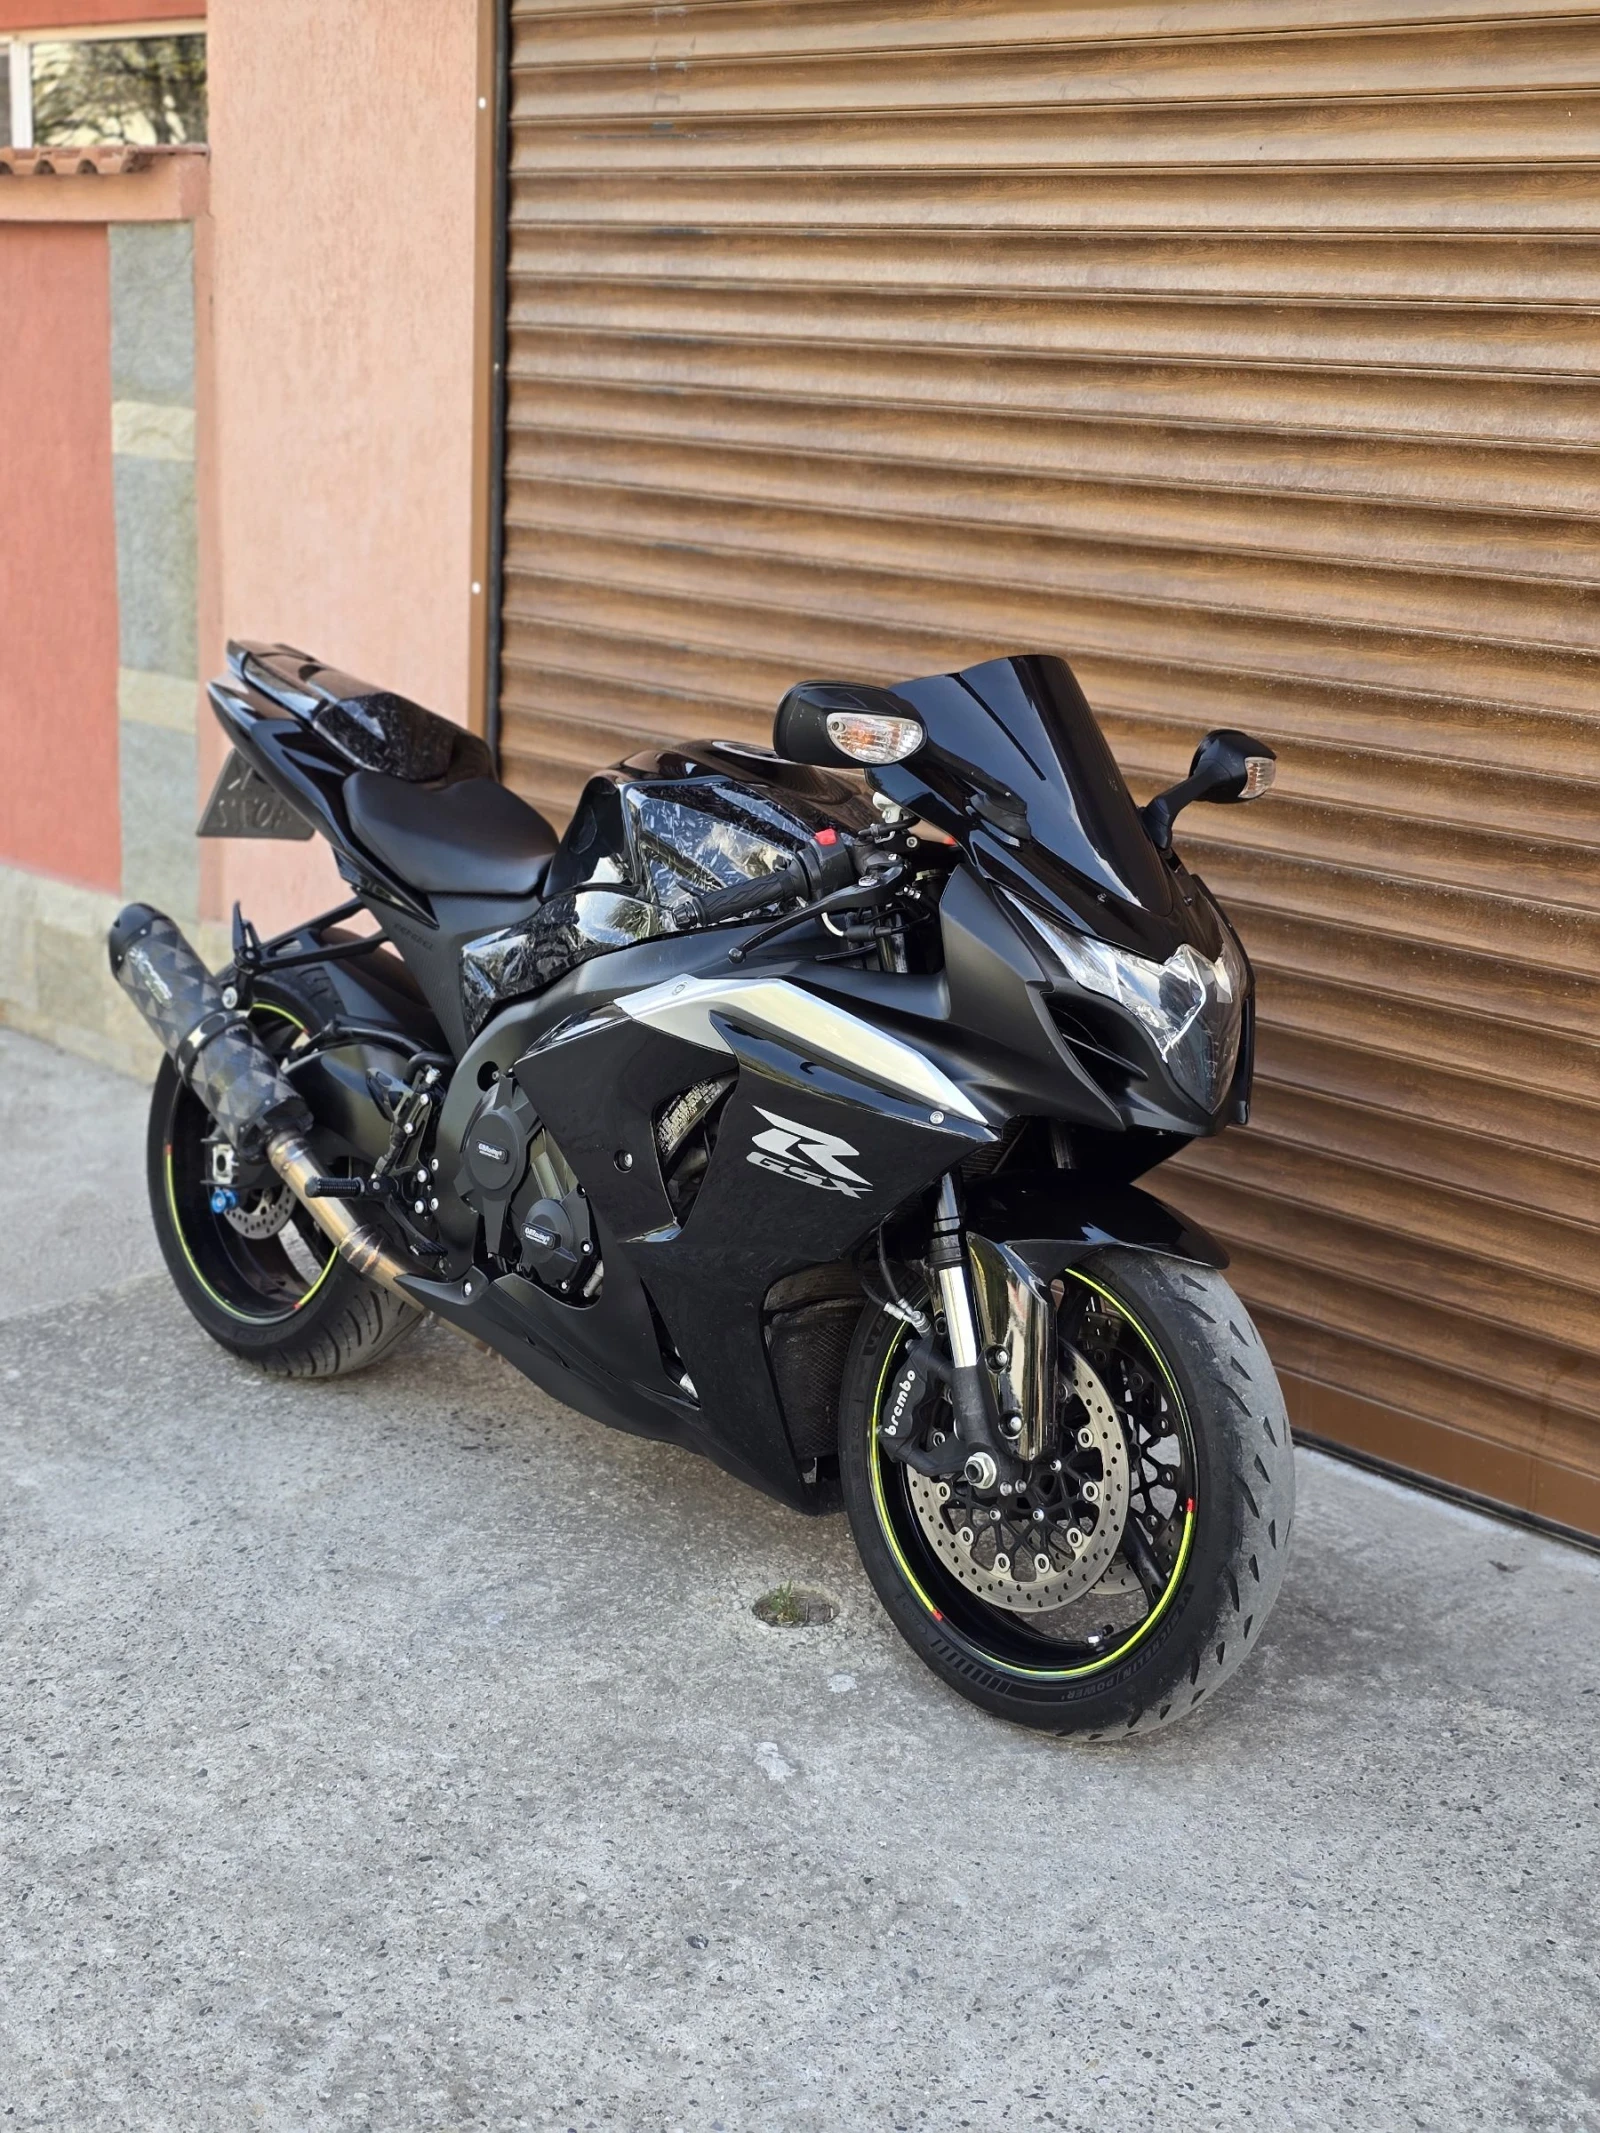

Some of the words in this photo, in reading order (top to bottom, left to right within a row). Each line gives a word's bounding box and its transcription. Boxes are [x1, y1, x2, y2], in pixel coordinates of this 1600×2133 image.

[746, 1151, 874, 1199] GSX
[751, 1103, 873, 1186] R
[885, 1370, 915, 1436] brembo
